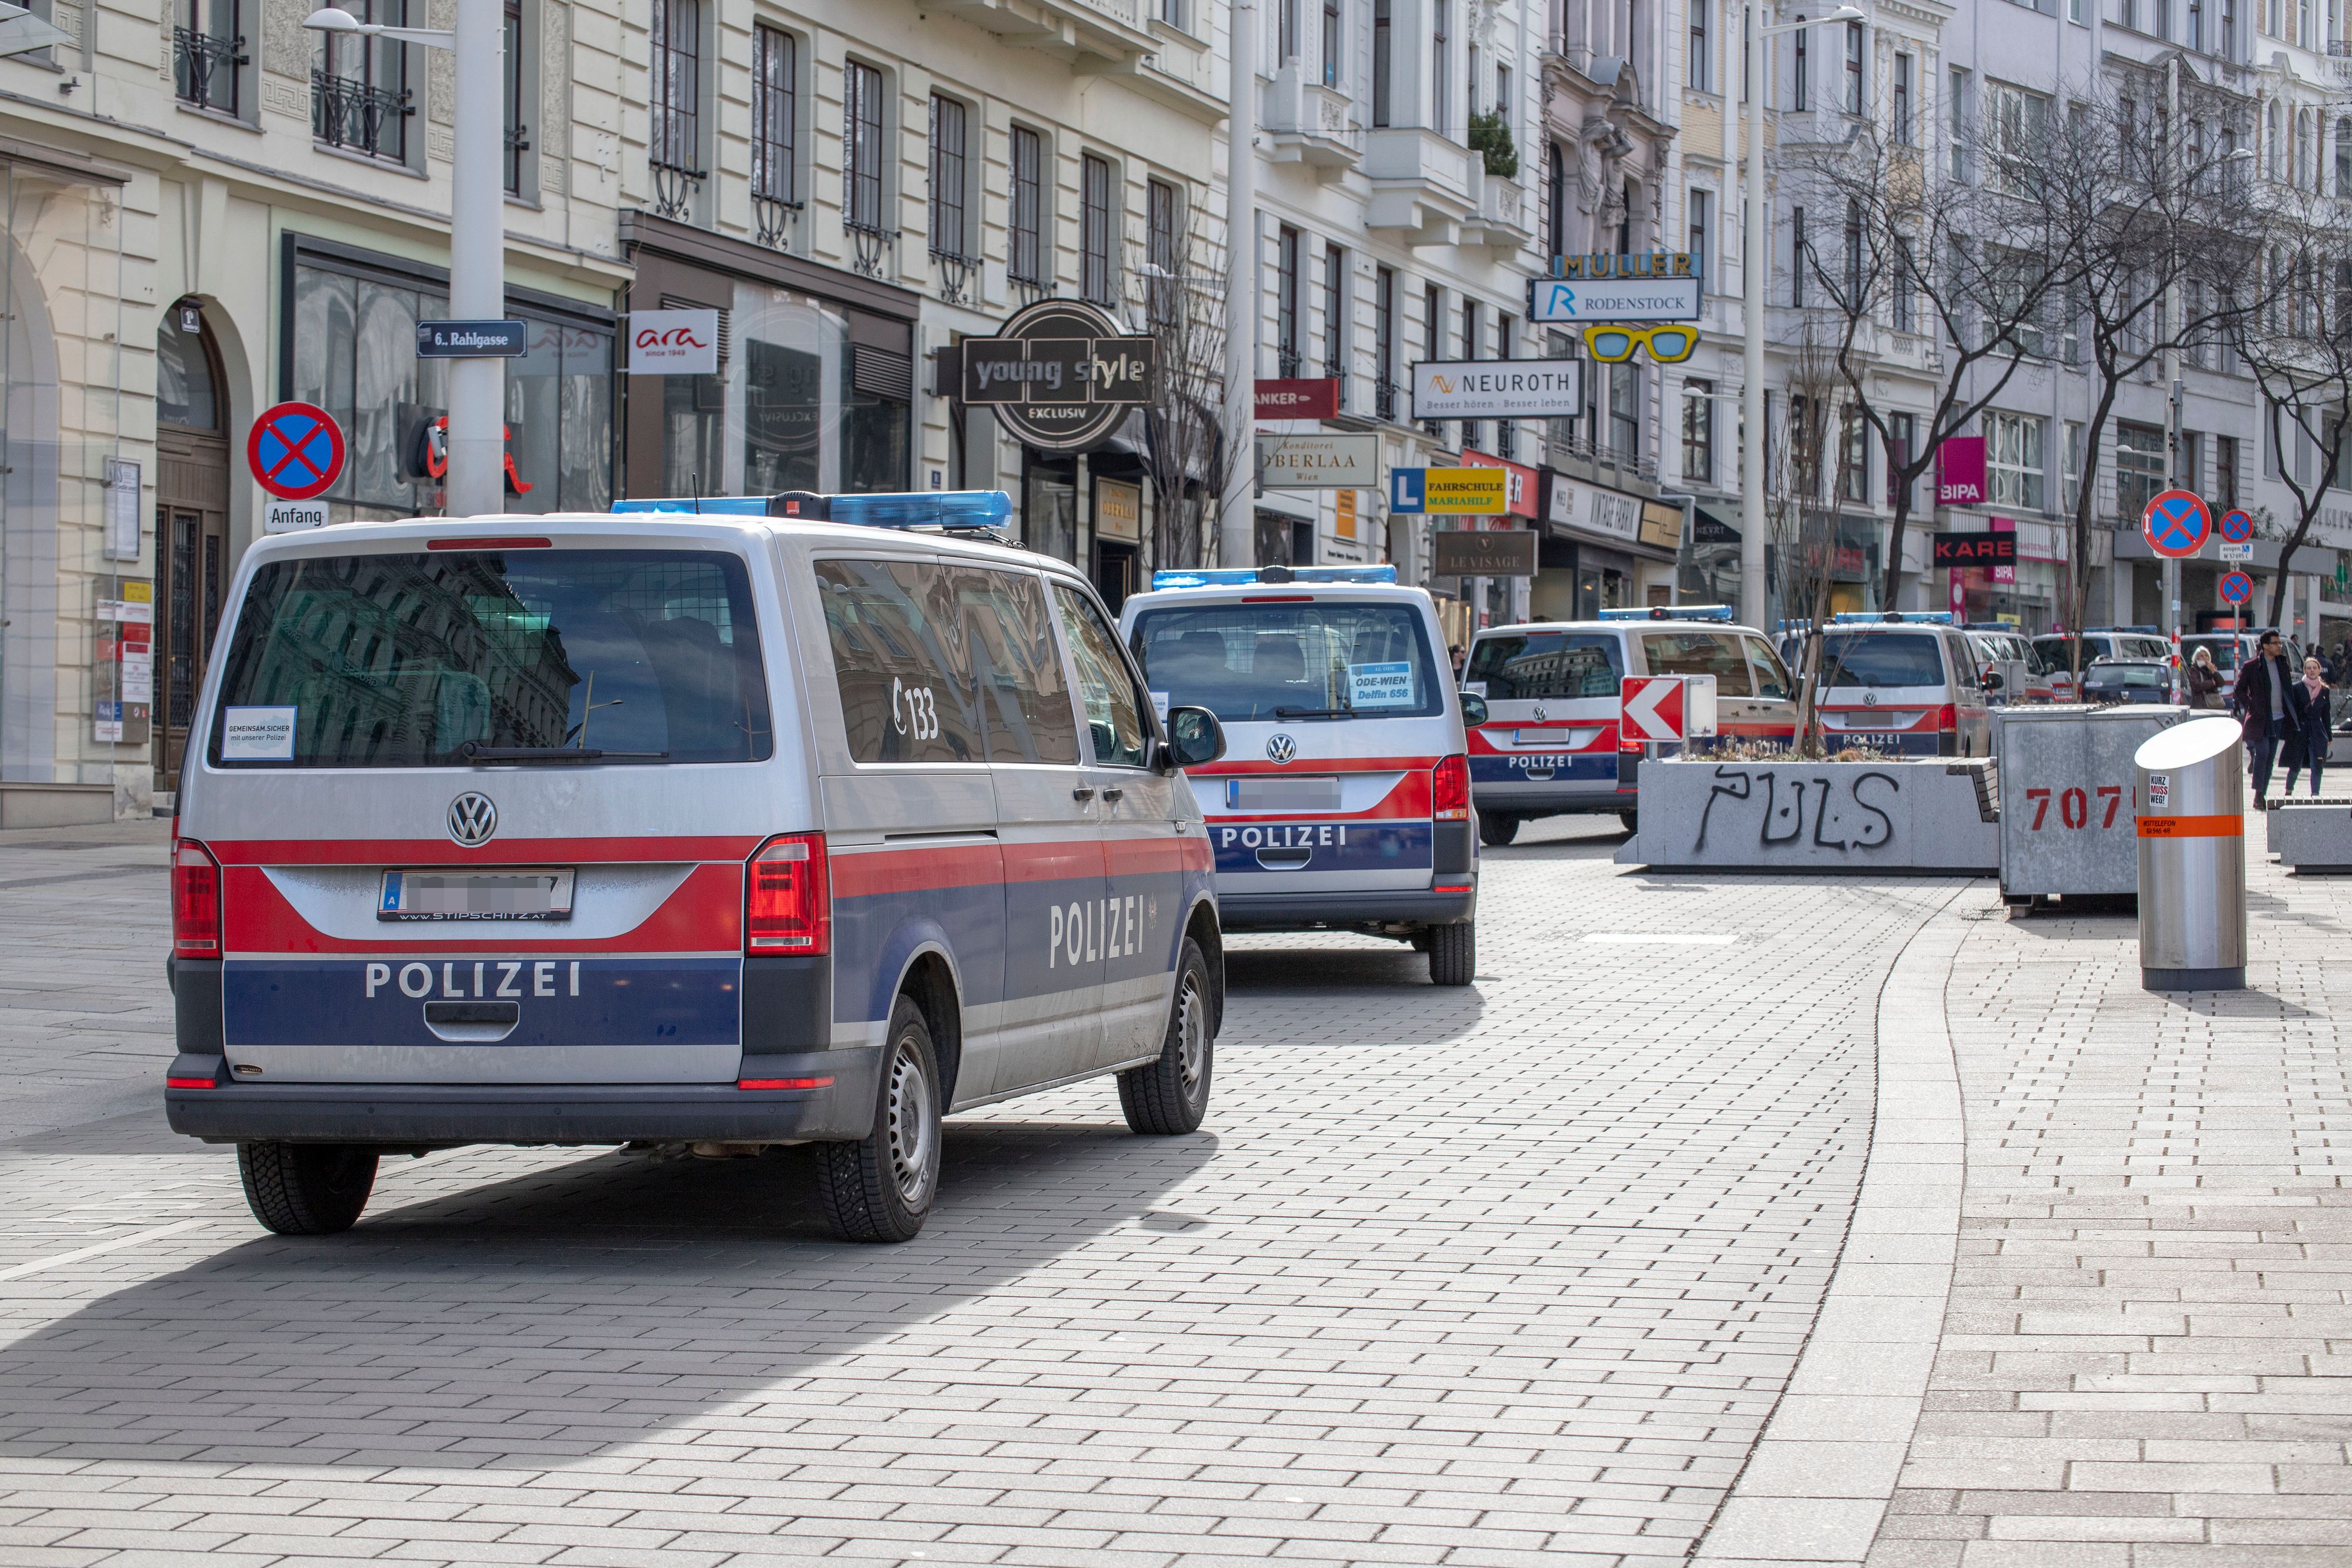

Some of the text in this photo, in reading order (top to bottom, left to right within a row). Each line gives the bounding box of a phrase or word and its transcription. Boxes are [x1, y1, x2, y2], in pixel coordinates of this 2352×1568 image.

[1563, 249, 1691, 277] MÜLLER
[1586, 297, 1685, 310] RODENSTOCK
[450, 332, 508, 348] Rahlgasse
[636, 328, 707, 348] ara
[976, 353, 1145, 389] young style
[1463, 374, 1569, 392] NEUROTH
[1464, 398, 1494, 408] hören
[1504, 399, 1536, 407] Besser
[1541, 398, 1569, 407] leben
[1029, 408, 1086, 419] EXCLUSIV
[1264, 454, 1355, 467] OBERLAA
[1398, 476, 1418, 505] L
[1429, 483, 1503, 492] FAHRSCHULE
[1941, 484, 1979, 499] BIPA
[1429, 497, 1494, 505] MARIAHILF
[272, 508, 321, 526] Anfang
[1591, 491, 1615, 528] VINTAGE
[1614, 497, 1637, 533] FABRIK
[1936, 541, 2013, 557] KARE
[1451, 556, 1520, 567] LE VISAGE
[1996, 566, 2013, 580] BIPA
[1356, 676, 1406, 687] ODE-WIEN
[1358, 688, 1408, 699] Delfin 656
[905, 687, 938, 740] 133
[1843, 735, 1900, 744] POLIZEI
[1509, 755, 1572, 768] POLIZEI
[2151, 776, 2166, 785] KURZ
[2150, 785, 2168, 795] MUSS
[2150, 794, 2165, 804] WEG!
[2026, 786, 2136, 831] 707
[1222, 825, 1345, 848] POLIZEI
[388, 896, 396, 905] A
[1050, 894, 1143, 968] POLIZEI
[366, 961, 580, 998] POLIZEI
